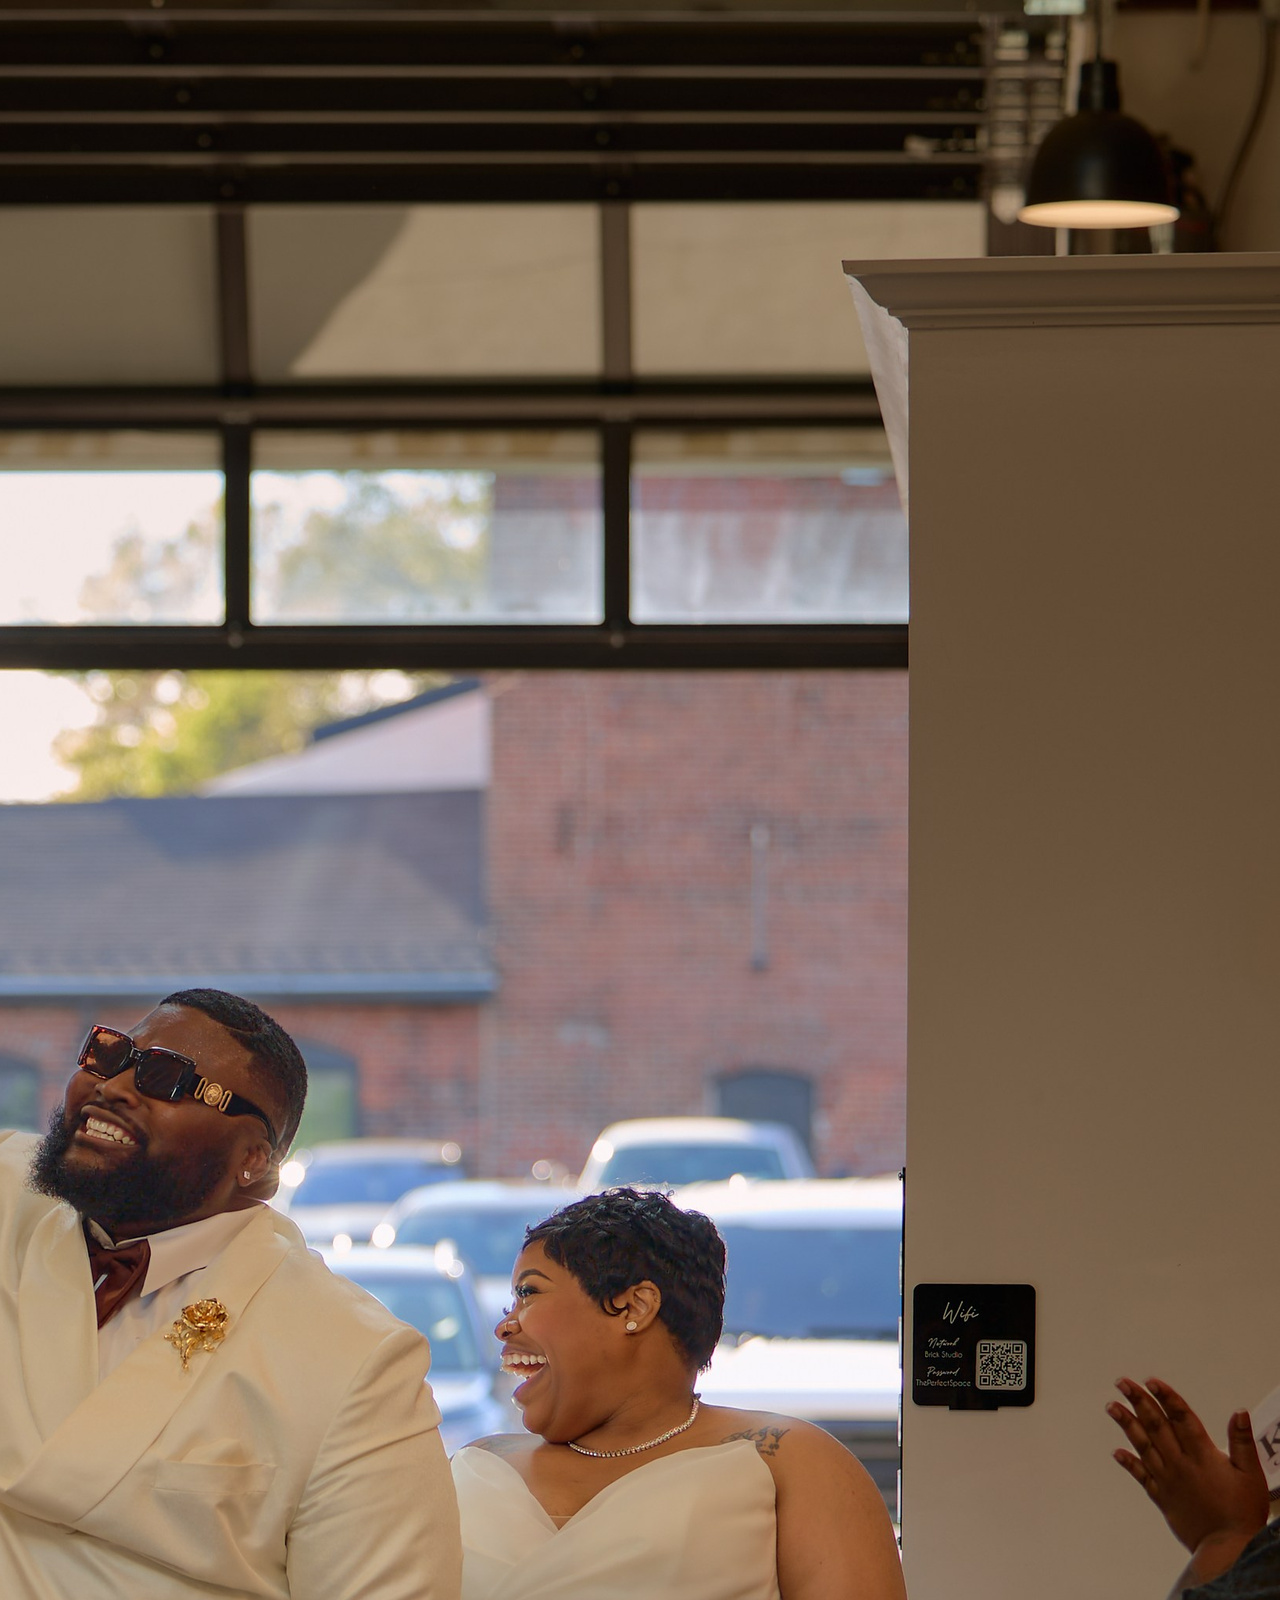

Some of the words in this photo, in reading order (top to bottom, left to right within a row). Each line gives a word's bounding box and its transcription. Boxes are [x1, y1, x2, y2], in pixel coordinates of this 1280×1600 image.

[942, 1300, 979, 1324] Wifi
[927, 1337, 960, 1348] Network
[924, 1350, 940, 1358] Brick
[941, 1350, 963, 1358] Studio
[927, 1366, 960, 1377] Password
[916, 1379, 971, 1387] ThePerfectSpace
